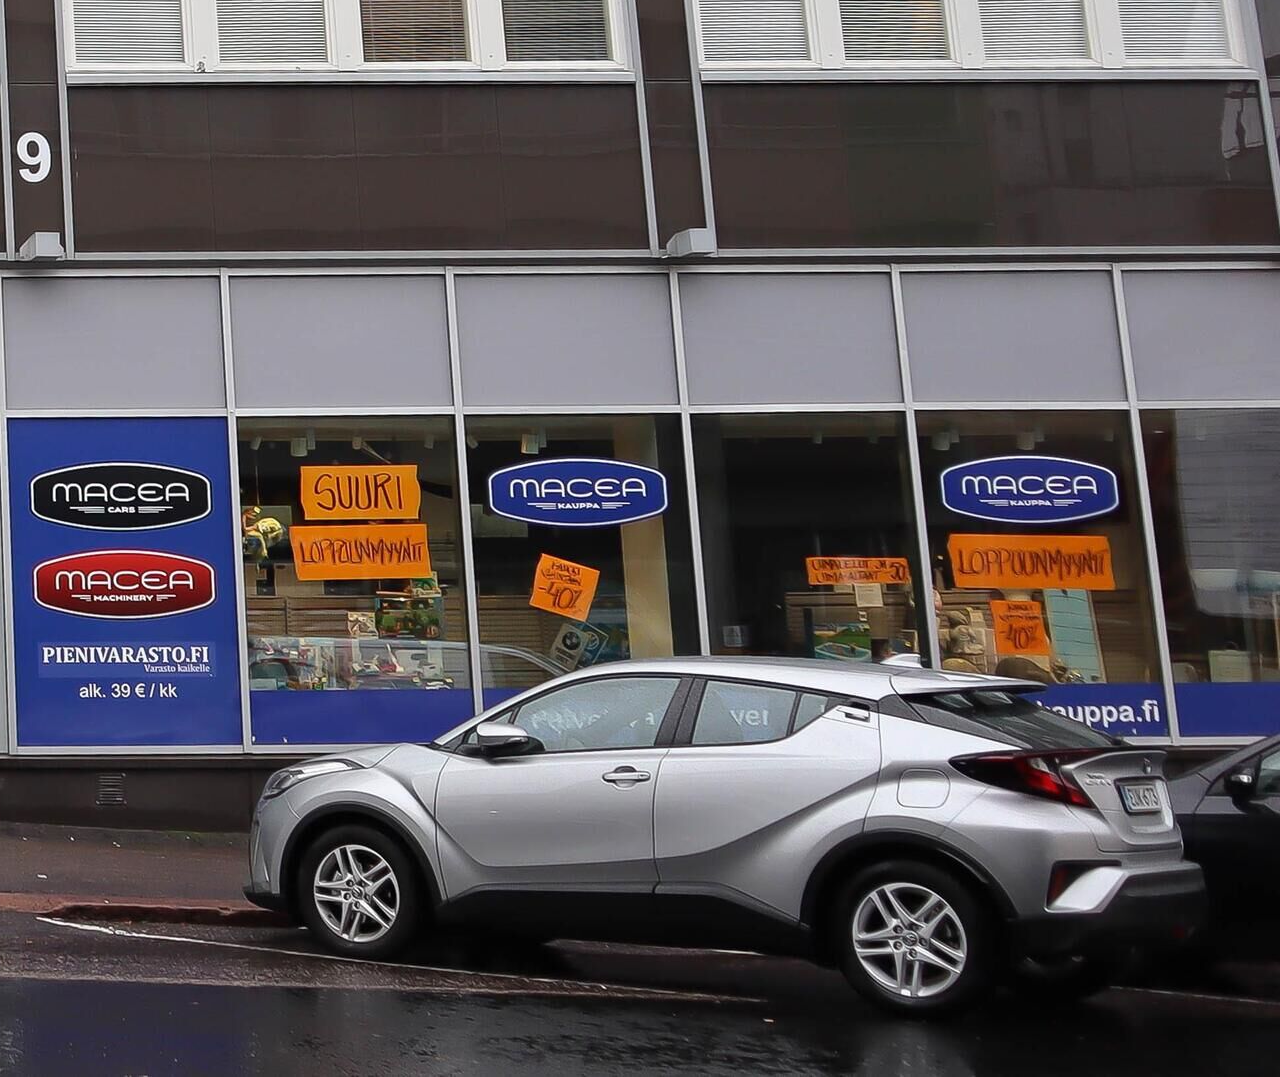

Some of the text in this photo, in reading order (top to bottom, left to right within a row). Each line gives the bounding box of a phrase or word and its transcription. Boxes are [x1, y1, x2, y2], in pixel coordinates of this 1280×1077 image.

[16, 132, 52, 183] 9
[52, 482, 190, 503] MACEA
[314, 473, 403, 511] SUURI
[510, 478, 647, 498] MACEA
[961, 475, 1098, 496] MACEA
[107, 506, 136, 514] CARS
[557, 502, 600, 510] KAUPPA
[1009, 499, 1052, 507] KAUPPA
[55, 570, 194, 591] MACEA
[92, 593, 154, 603] MACHINERY
[42, 646, 209, 664] PIENIVARASTO.FI
[143, 663, 211, 673] Varasto kaikelle
[79, 683, 106, 699] alk.
[111, 684, 131, 699] 39
[134, 684, 146, 699] €
[159, 683, 178, 699] kk
[1040, 699, 1160, 729] auppa.fi
